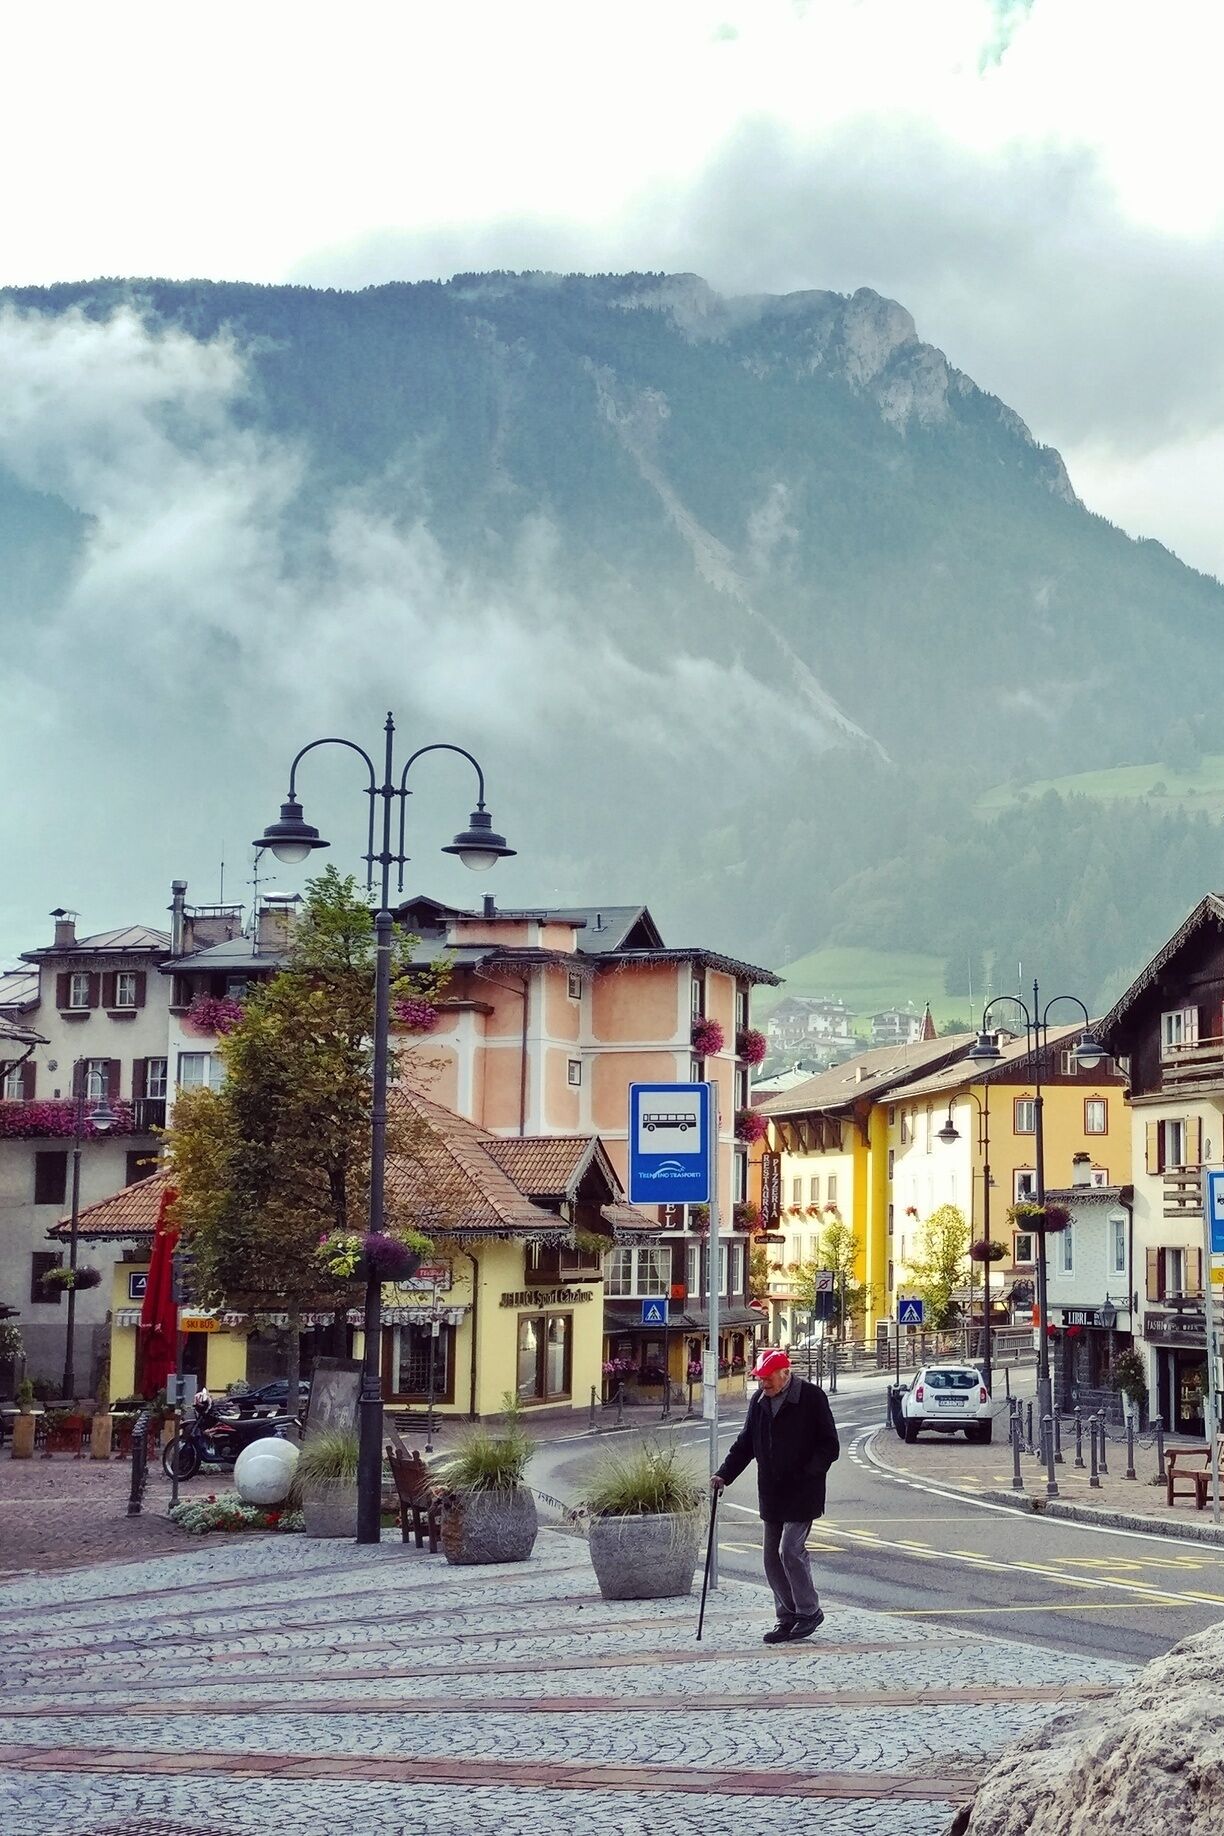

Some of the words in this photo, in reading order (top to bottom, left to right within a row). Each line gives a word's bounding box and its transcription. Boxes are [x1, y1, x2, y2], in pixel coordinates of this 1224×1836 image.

[771, 1159, 779, 1218] PIZZERIA
[534, 1289, 557, 1309] Sport
[187, 1319, 198, 1329] SKI
[200, 1319, 214, 1329] BUS
